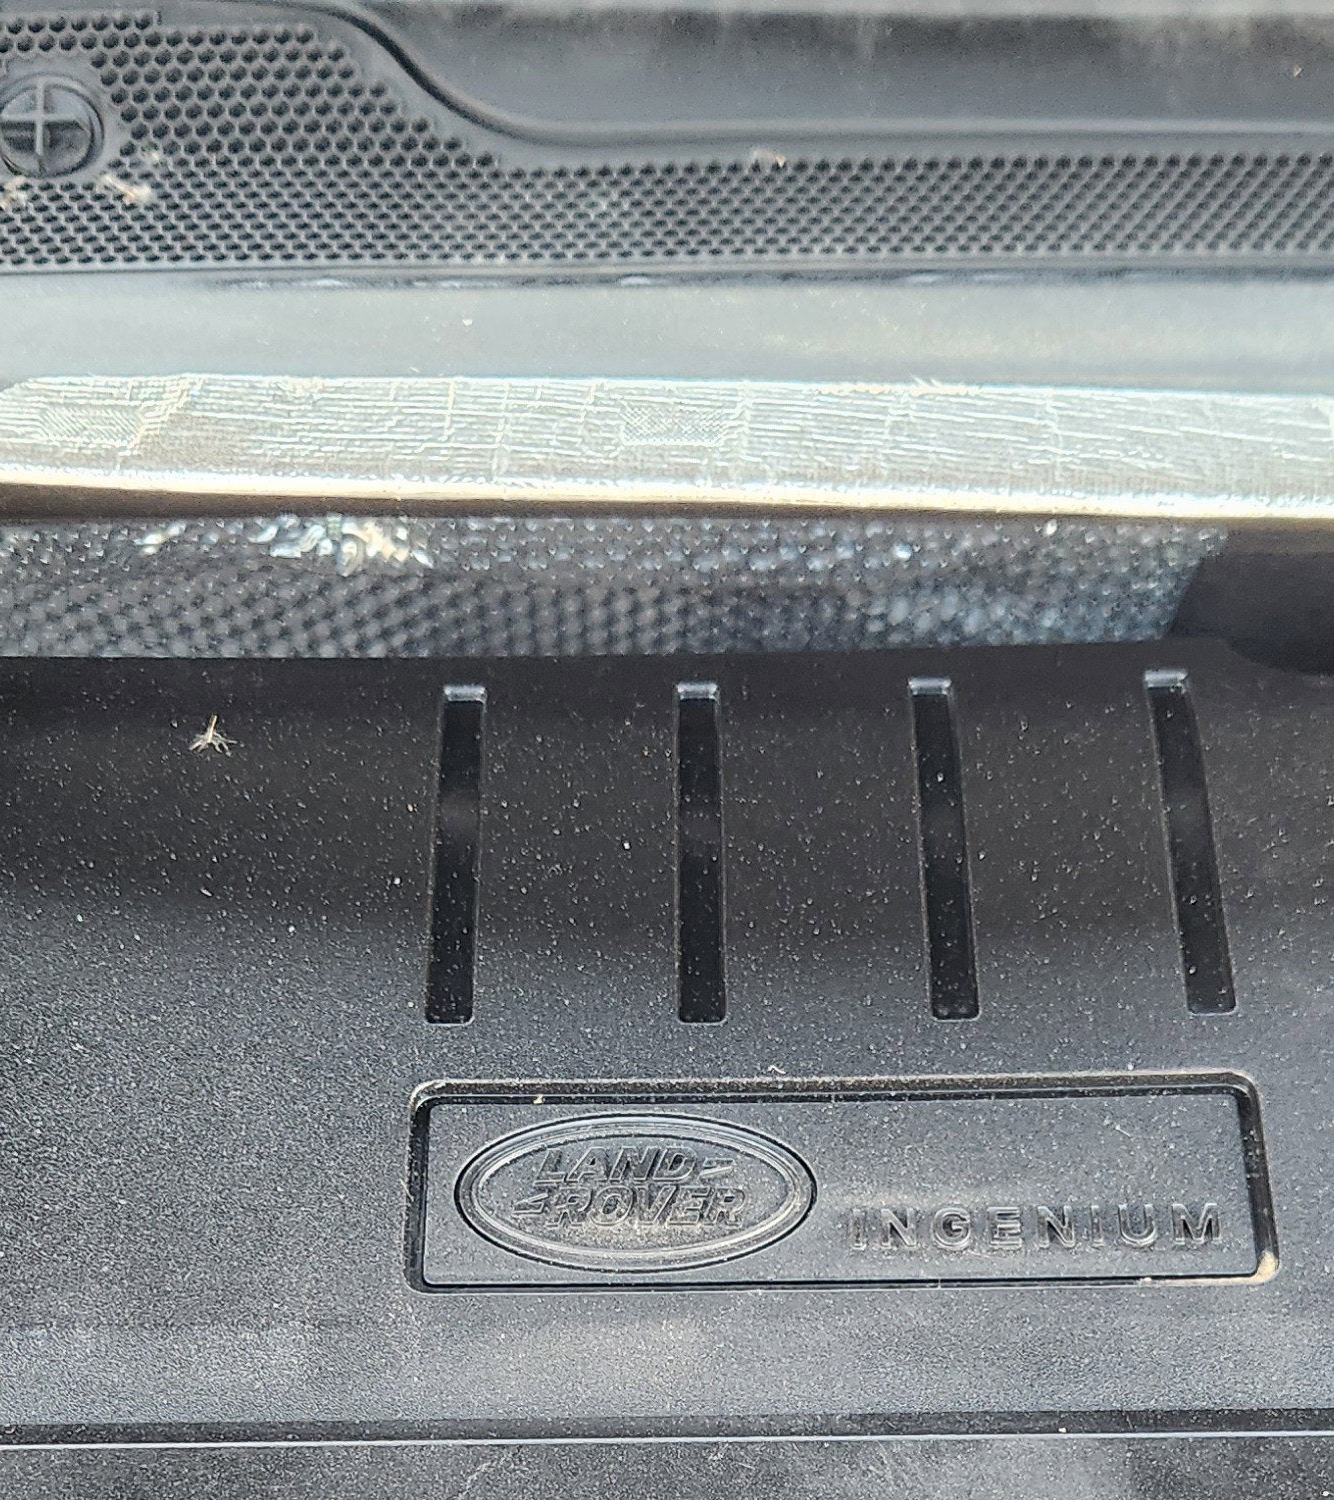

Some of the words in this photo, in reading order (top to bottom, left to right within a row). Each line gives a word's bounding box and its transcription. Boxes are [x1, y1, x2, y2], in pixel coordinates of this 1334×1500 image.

[534, 1145, 697, 1186] LAND
[547, 1185, 748, 1228] ROVER
[851, 1202, 1221, 1250] INGENIUM
